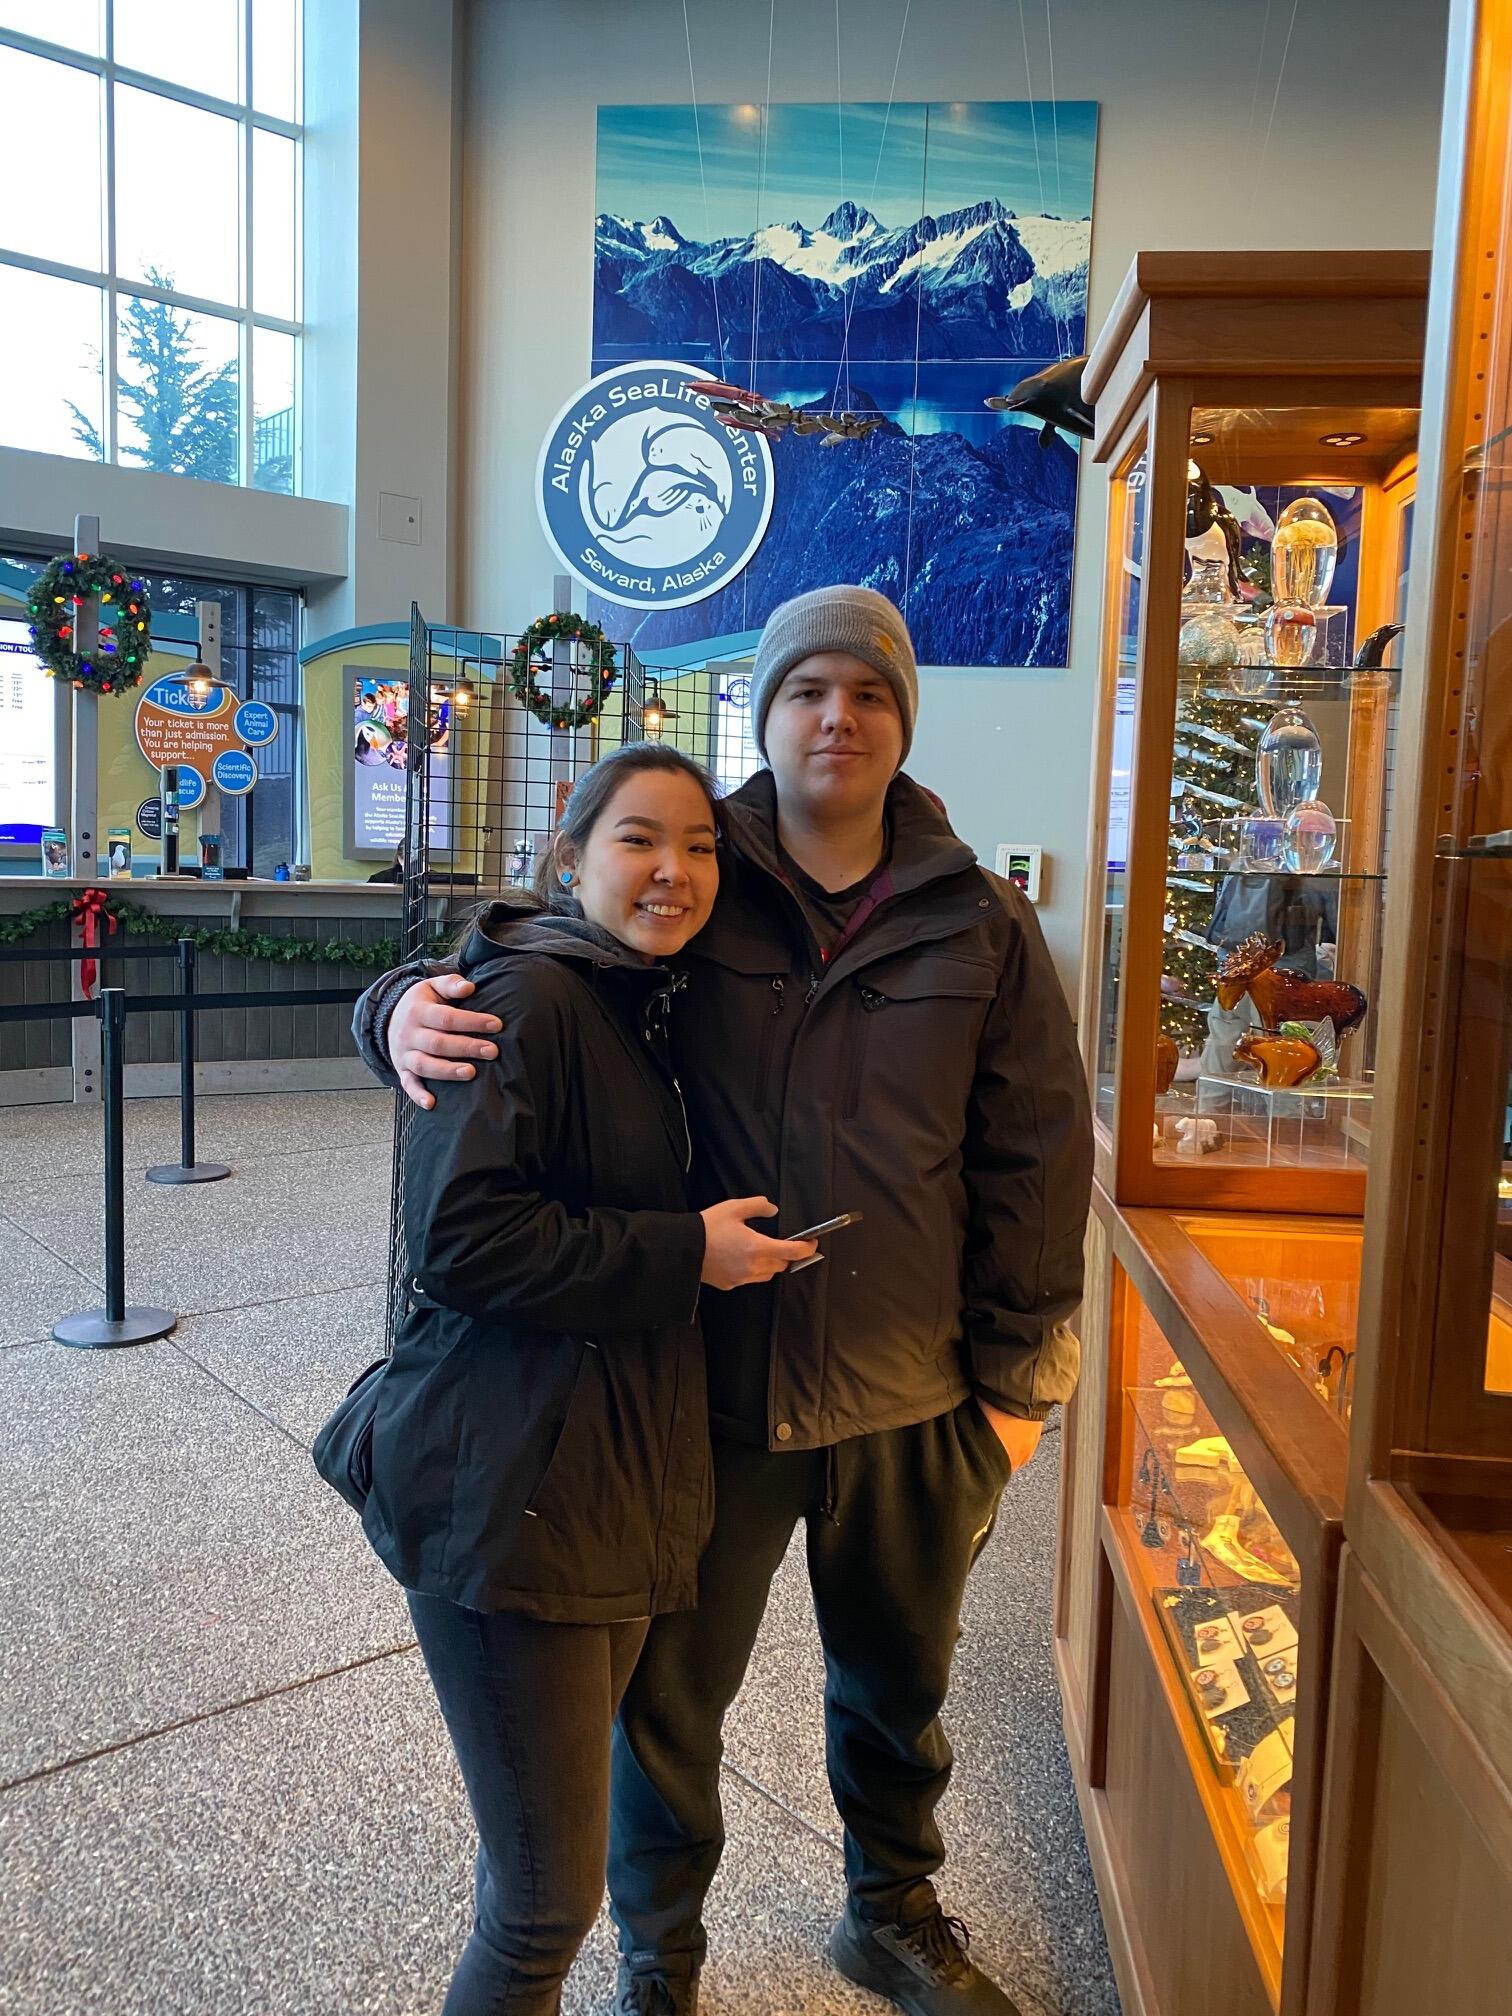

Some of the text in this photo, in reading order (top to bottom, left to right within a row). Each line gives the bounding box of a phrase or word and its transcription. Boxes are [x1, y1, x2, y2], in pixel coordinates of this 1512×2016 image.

[552, 378, 758, 497] Alaska SeaLife enter
[580, 548, 727, 594] Seward, Alaska
[18, 645, 35, 653] TOU
[244, 711, 268, 721] Expert
[144, 717, 229, 731] Your ticket is more
[244, 720, 268, 728] Animal
[140, 728, 230, 741] than just admission.
[247, 728, 265, 736] Care
[144, 738, 213, 752] You are helping
[150, 750, 195, 761] support...
[217, 762, 251, 772] Scientific
[217, 771, 251, 782] Discovery
[179, 779, 197, 787] dlife
[372, 782, 388, 792] Ask
[390, 783, 401, 792] Us
[372, 793, 406, 802] Membe
